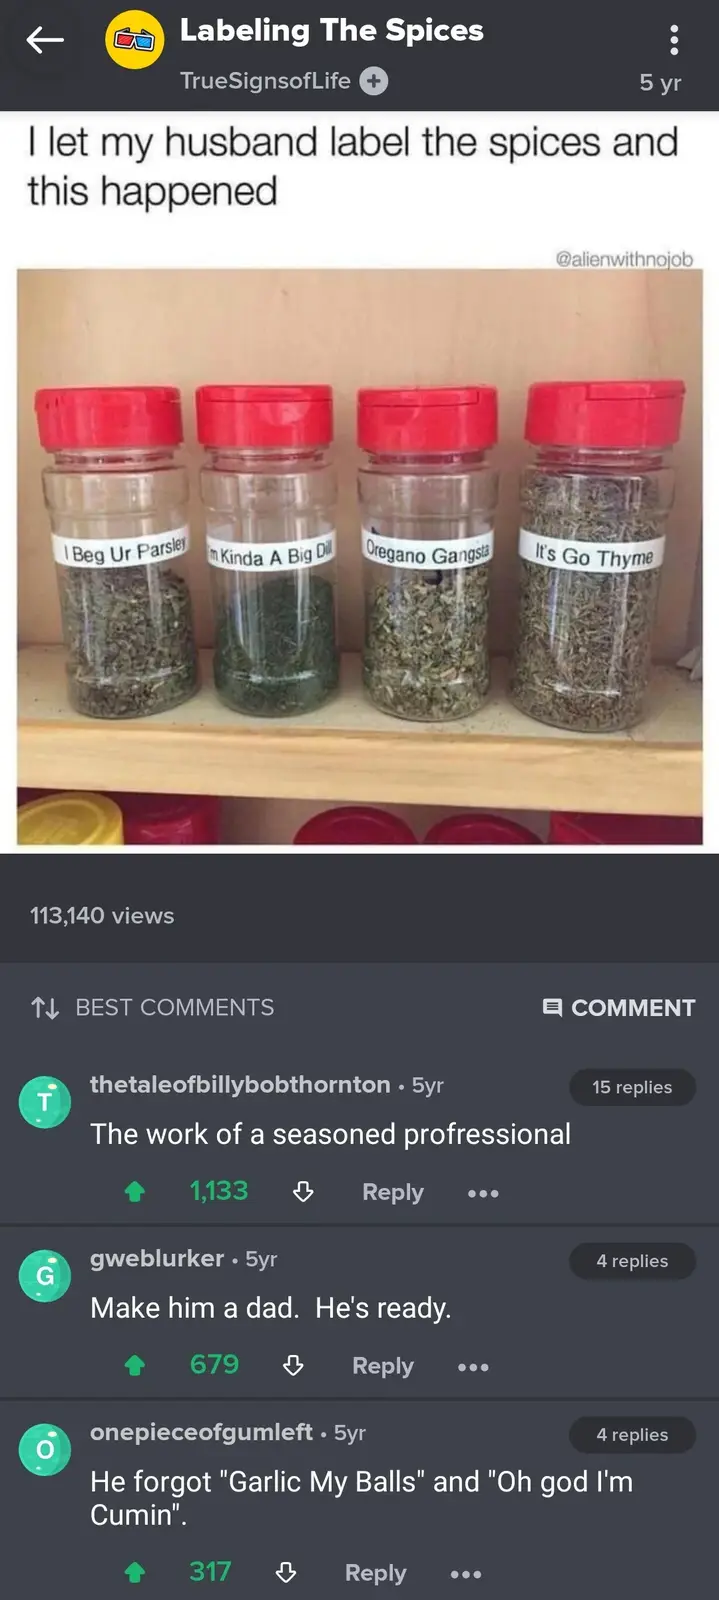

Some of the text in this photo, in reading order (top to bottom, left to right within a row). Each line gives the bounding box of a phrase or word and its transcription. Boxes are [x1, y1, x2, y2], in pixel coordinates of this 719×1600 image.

[181, 17, 484, 47] Labeling The Spices
[180, 72, 351, 93] TrueSignsofLife
[641, 74, 681, 95] 5 yr
[73, 546, 104, 566] Beg
[111, 545, 133, 562] Ur
[138, 537, 186, 560] Parsley
[221, 548, 263, 566] Kinda
[270, 549, 282, 565] A
[288, 545, 312, 565] Big
[367, 538, 490, 566] Oregano Gangsta
[536, 543, 653, 570] It's Go Thyme
[30, 907, 174, 927] 113,140 views
[77, 999, 274, 1016] BEST COMMENTS
[572, 999, 696, 1016] COMMENT
[90, 1075, 444, 1097] thetaleofbillybobthornton 5yr
[593, 1081, 672, 1097] 15 replies
[37, 1093, 52, 1111] T
[90, 1122, 570, 1150] The work of a seasoned profressional
[191, 1180, 248, 1203] 1,133
[364, 1183, 424, 1205] Reply
[91, 1249, 277, 1271] gweblurker 5yr
[597, 1254, 668, 1271] 4 replies
[37, 1266, 54, 1285] G
[92, 1296, 450, 1324] Make him a dad. He's ready.
[191, 1354, 238, 1374] 679
[354, 1357, 414, 1378] Reply
[91, 1422, 366, 1445] onepieceofgumleft 5yr
[597, 1428, 668, 1445] 4 replies
[37, 1440, 54, 1459] O
[92, 1470, 632, 1498] He forgot "Garlic My Balls" and "Oh god I'm
[91, 1503, 186, 1525] Cumin".
[190, 1560, 231, 1581] 317
[346, 1564, 407, 1586] Reply
